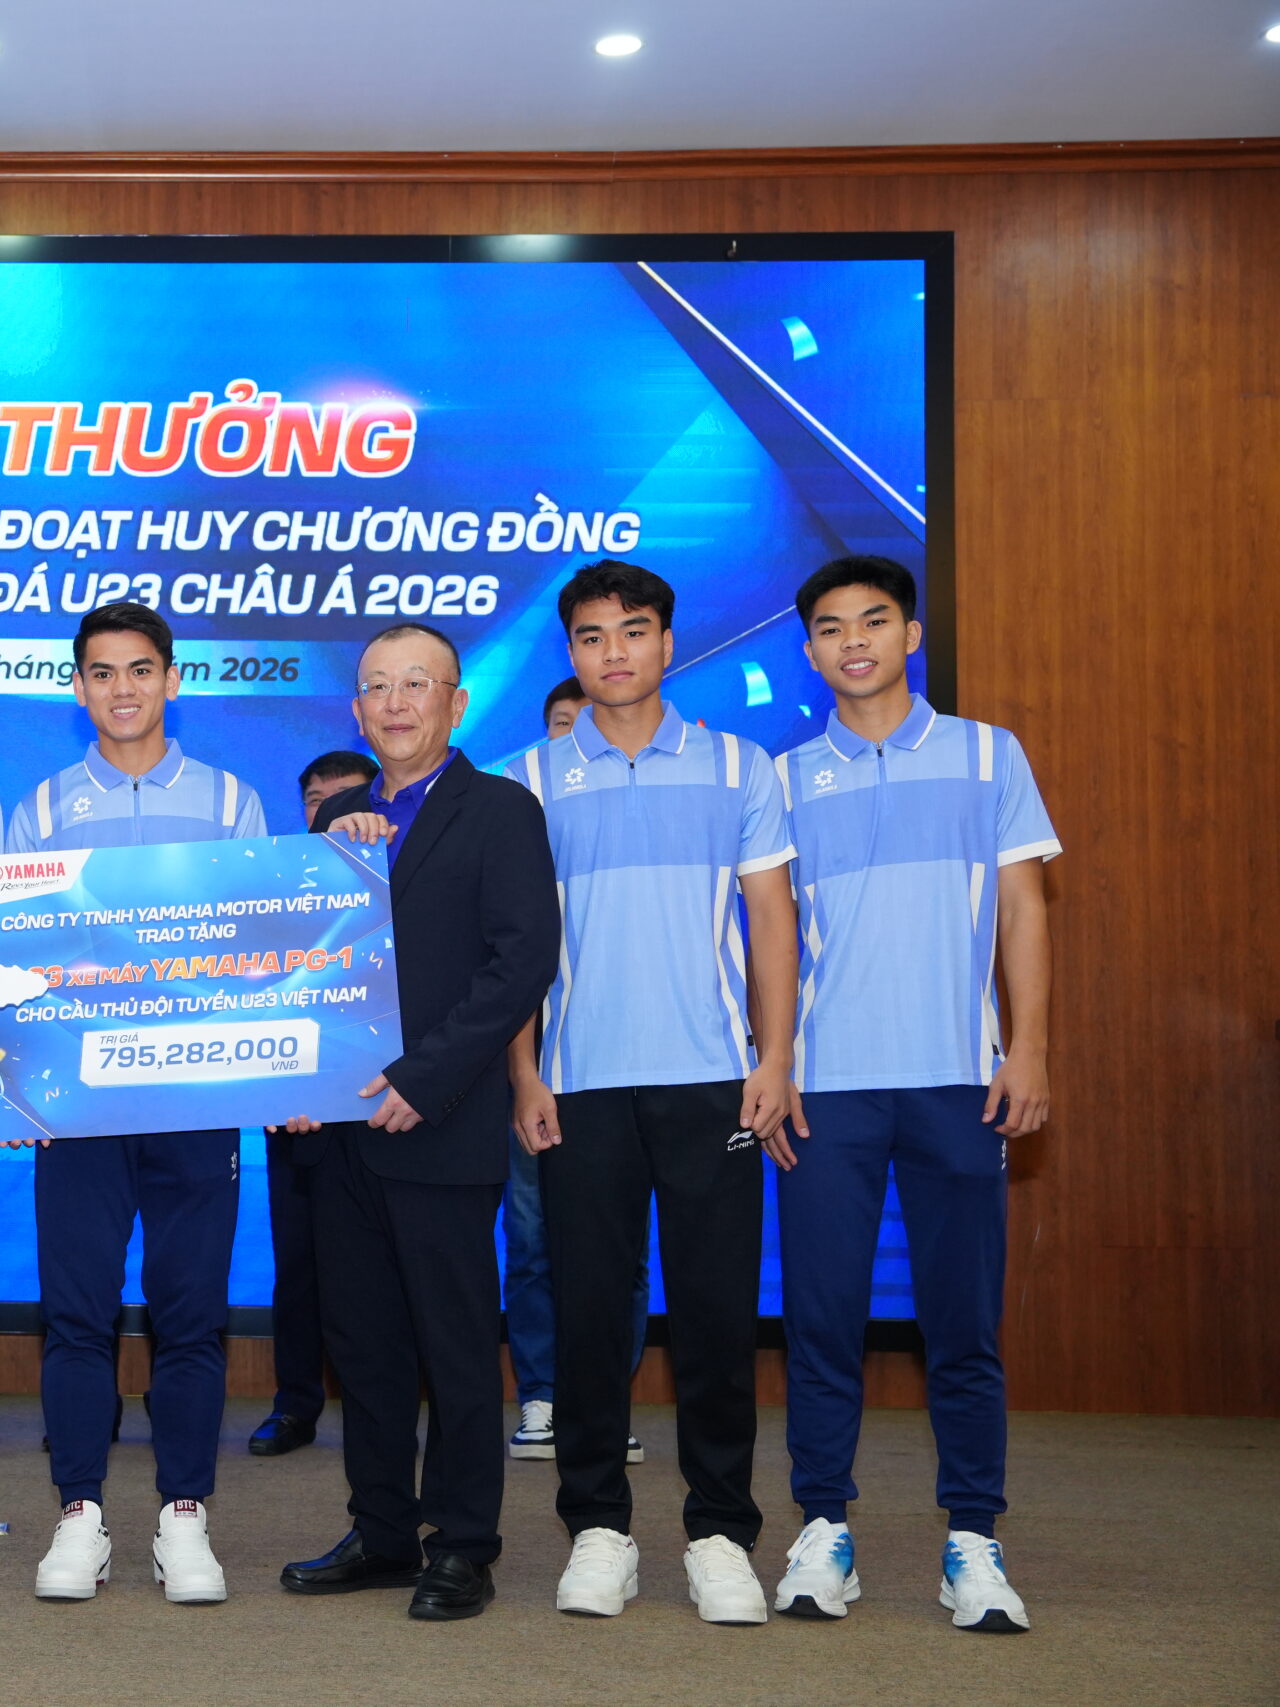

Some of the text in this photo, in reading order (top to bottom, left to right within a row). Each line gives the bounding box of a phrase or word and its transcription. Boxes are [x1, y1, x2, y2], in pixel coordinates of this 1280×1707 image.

[137, 510, 249, 551] HUY
[252, 505, 480, 552] CHƯƠNG
[486, 492, 641, 552] ĐỒNG
[61, 573, 162, 612] U23
[170, 563, 316, 615] CHÂU
[318, 563, 357, 615] Á
[364, 574, 499, 616] 2026
[219, 656, 300, 683] 2026
[5, 862, 65, 880] YAMAHA
[1, 892, 370, 931] CÔNG TY TNHH YAMAHA MOTOR VIỆT NAM
[135, 921, 237, 944] TRAO TẶNG
[66, 968, 97, 986] XE
[99, 962, 149, 984] MÁY
[150, 951, 280, 981] YAMAHA
[284, 946, 353, 972] PG-1
[16, 986, 367, 1023] CHO CẦU THỦ ĐỘI TUYỂN U23 VIỆT NAM
[99, 1032, 139, 1045] TRỊ GIÁ
[99, 1036, 298, 1070] 795,282,000
[271, 1060, 299, 1071] VNĐ
[727, 1139, 755, 1151] LI-NING
